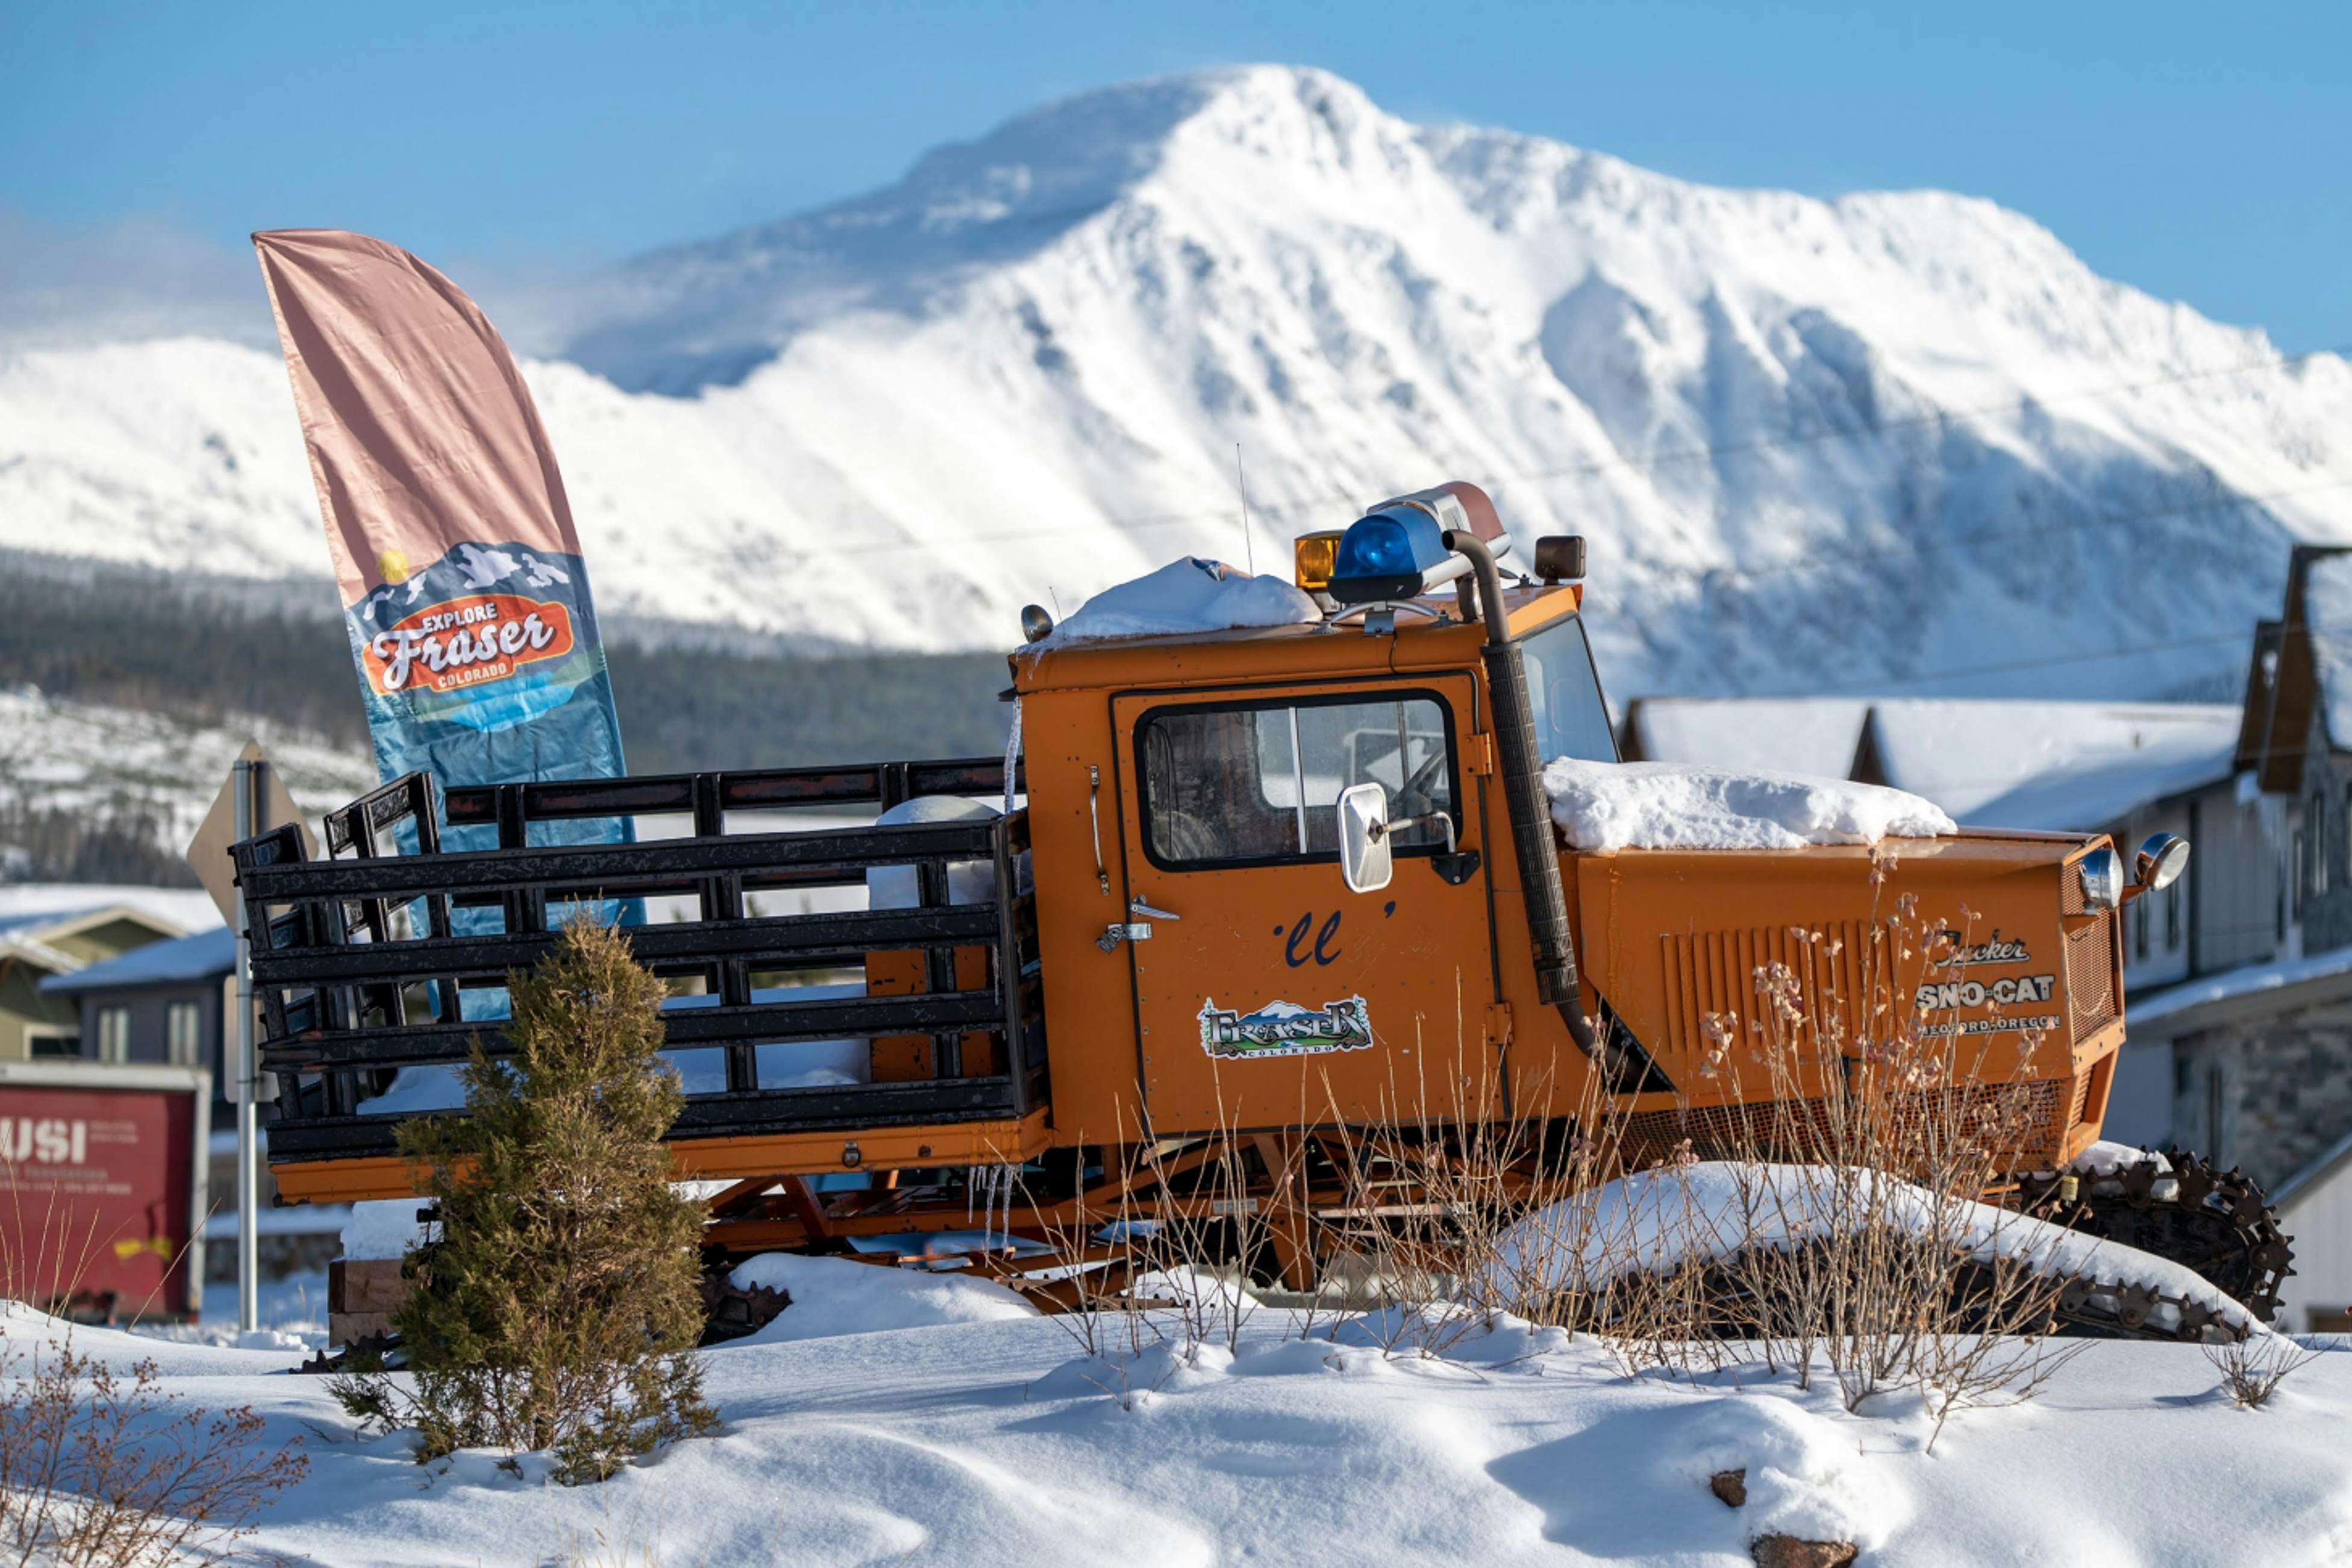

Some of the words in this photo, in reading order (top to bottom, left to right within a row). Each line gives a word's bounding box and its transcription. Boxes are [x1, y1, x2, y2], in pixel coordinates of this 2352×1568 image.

[422, 602, 498, 633] EXPLORE
[372, 613, 555, 689] Fraser
[437, 662, 507, 689] COLORADO
[1915, 974, 2056, 1010] SNO-CAT
[1206, 1001, 1371, 1045] FRASER
[1248, 1045, 1333, 1057] COLORADO
